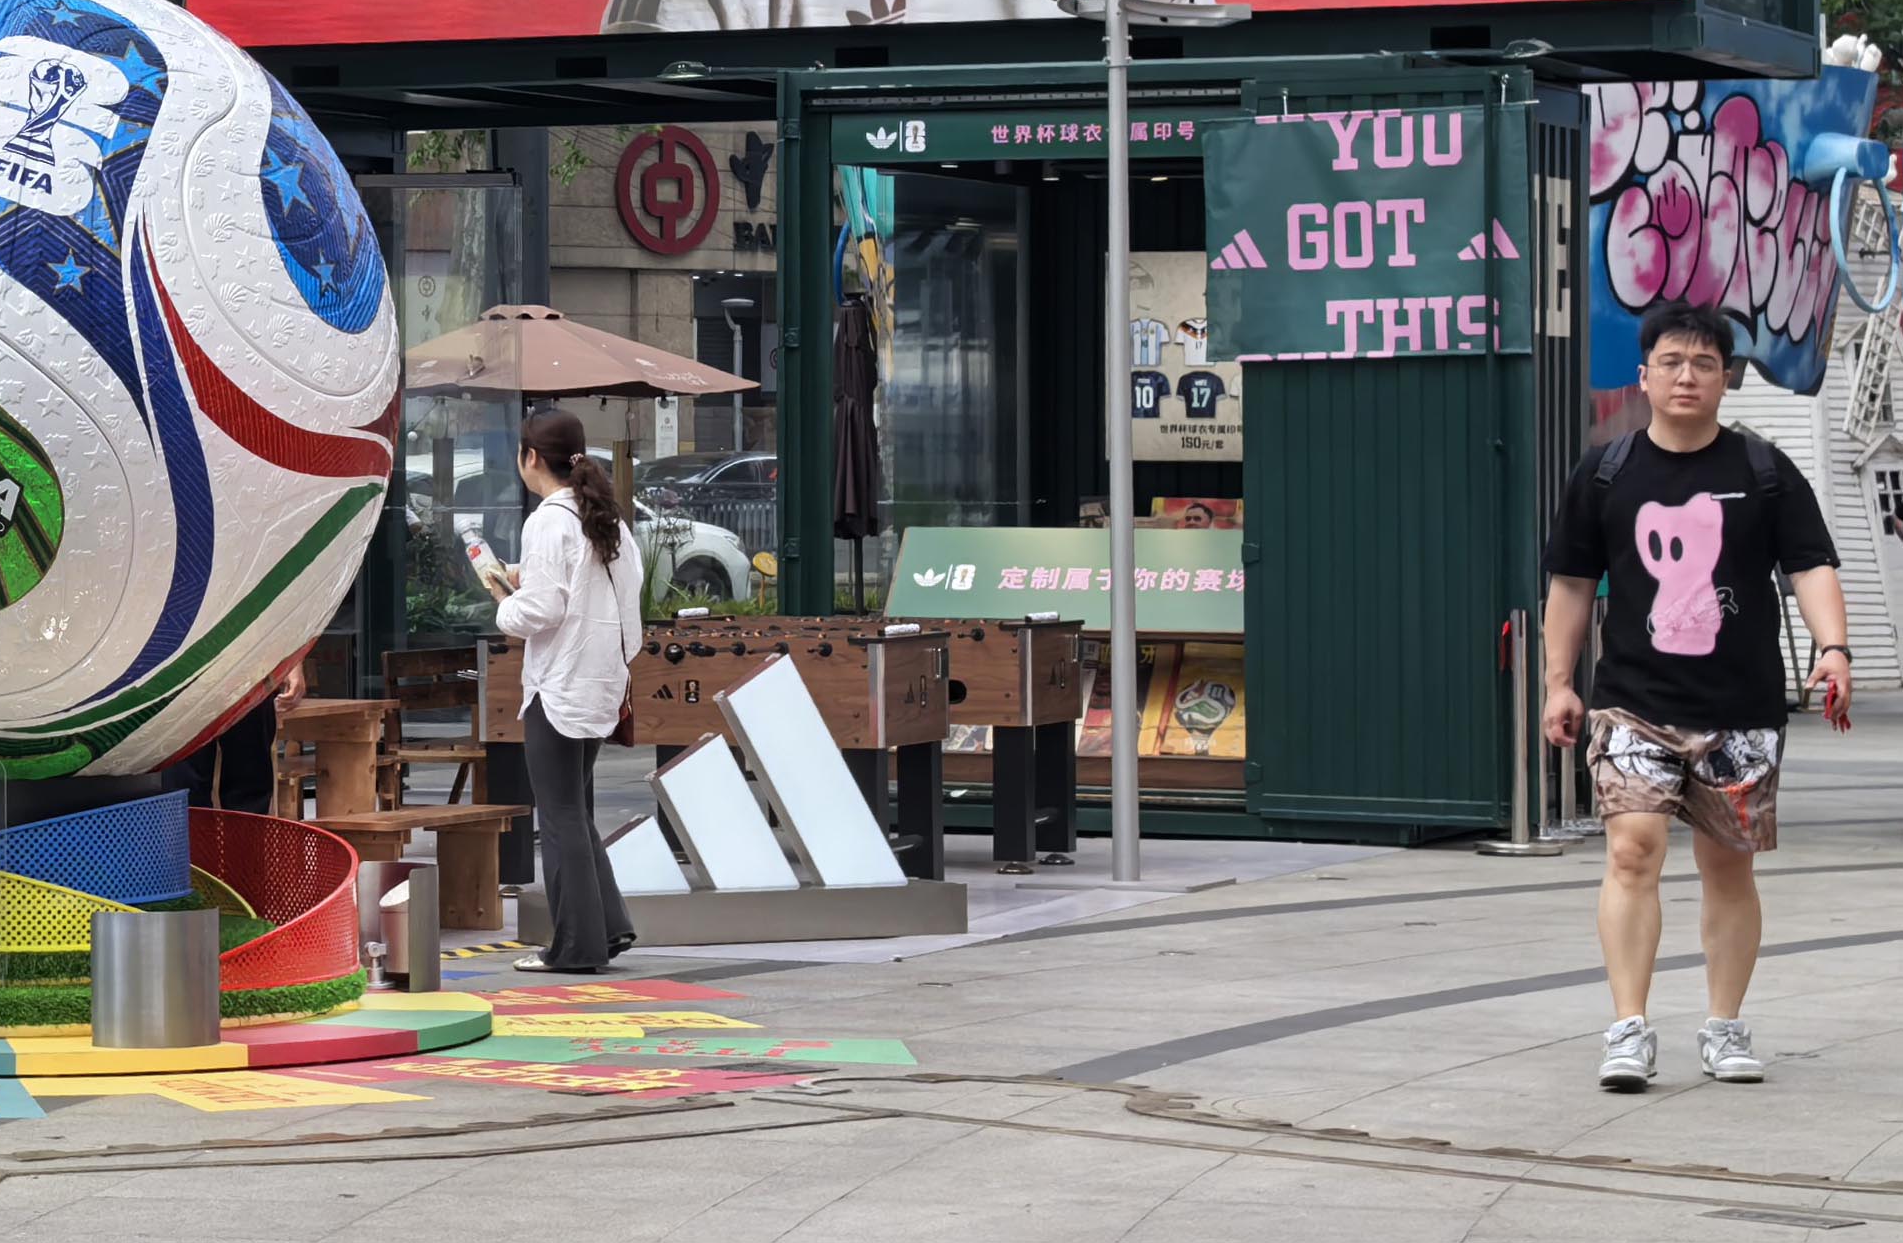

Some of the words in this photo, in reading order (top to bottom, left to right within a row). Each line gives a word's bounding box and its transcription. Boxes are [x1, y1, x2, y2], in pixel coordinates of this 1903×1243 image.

[991, 121, 1196, 145] 世界杯球衣属印号
[1308, 110, 1462, 171] YOU
[1287, 198, 1425, 271] GOT
[1326, 295, 1499, 358] THIS
[1135, 386, 1154, 408] 10
[1191, 386, 1211, 409] 17
